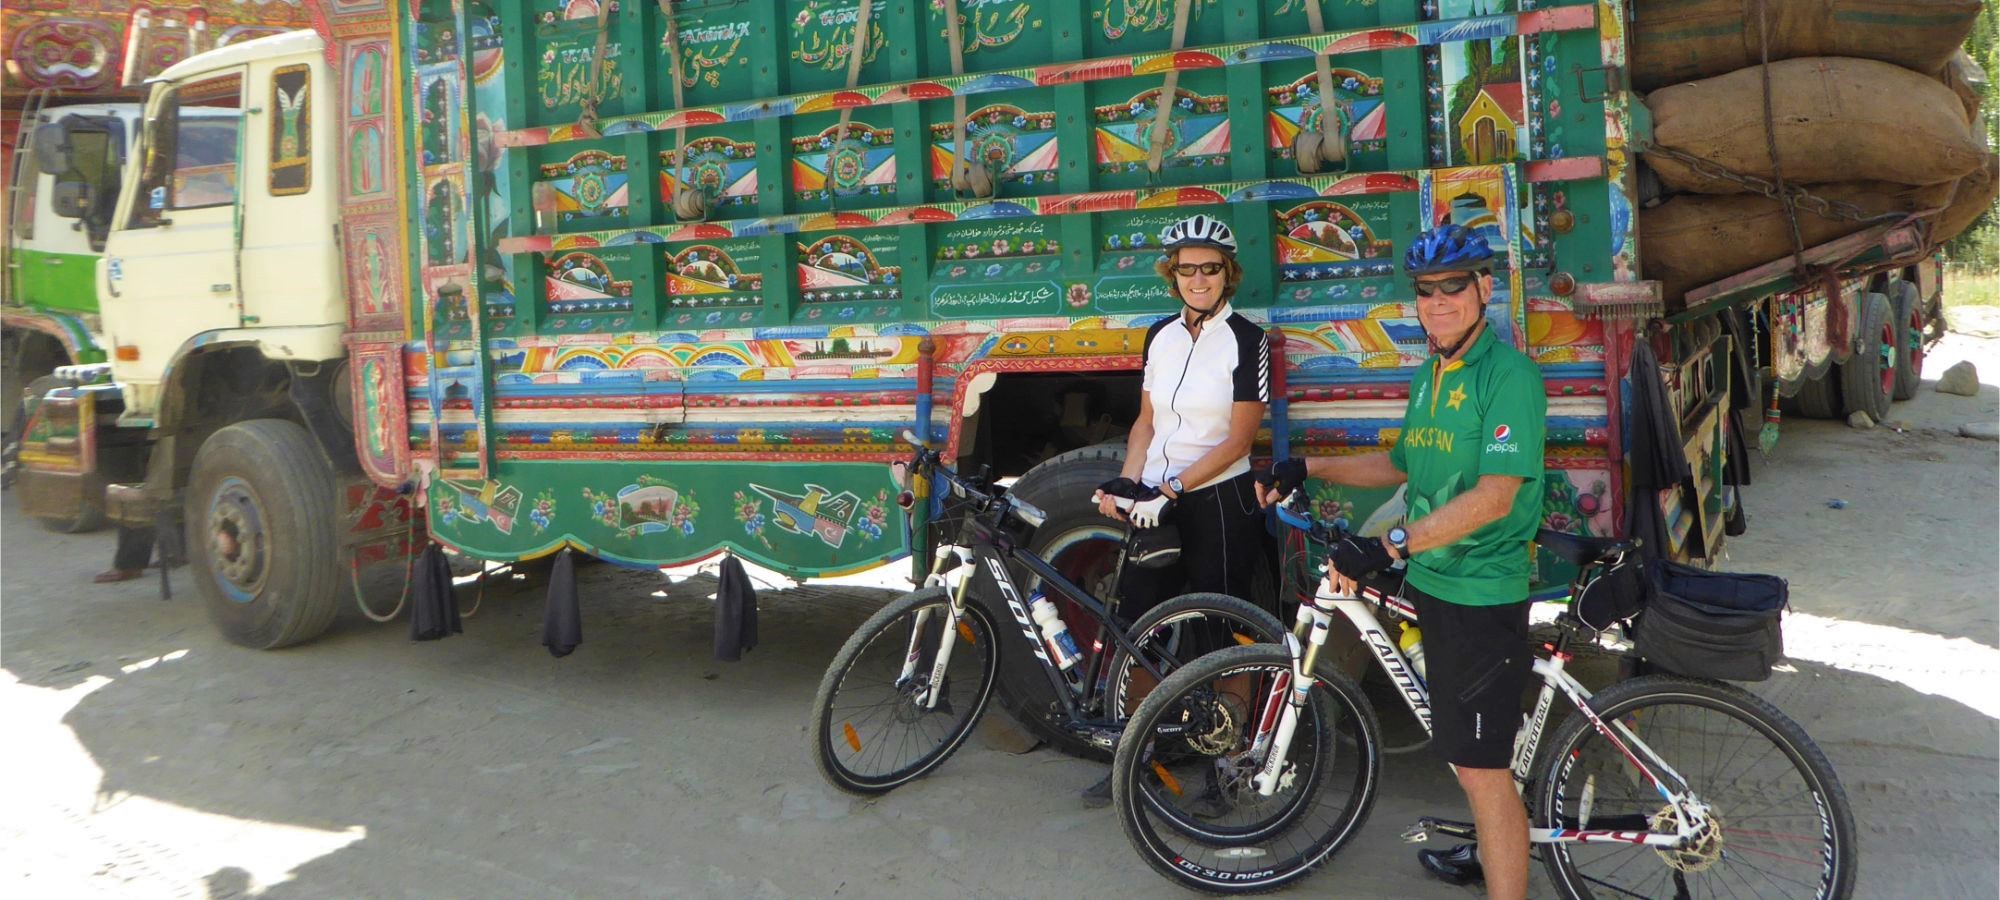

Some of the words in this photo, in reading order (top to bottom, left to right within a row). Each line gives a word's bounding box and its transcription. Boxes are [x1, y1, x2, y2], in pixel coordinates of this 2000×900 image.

[1404, 427, 1454, 454] AKSAN
[1485, 442, 1519, 455] pepsi
[984, 556, 1053, 667] SCOTT
[1365, 629, 1432, 731] CANNON
[1519, 695, 1550, 777] CANNONDALE
